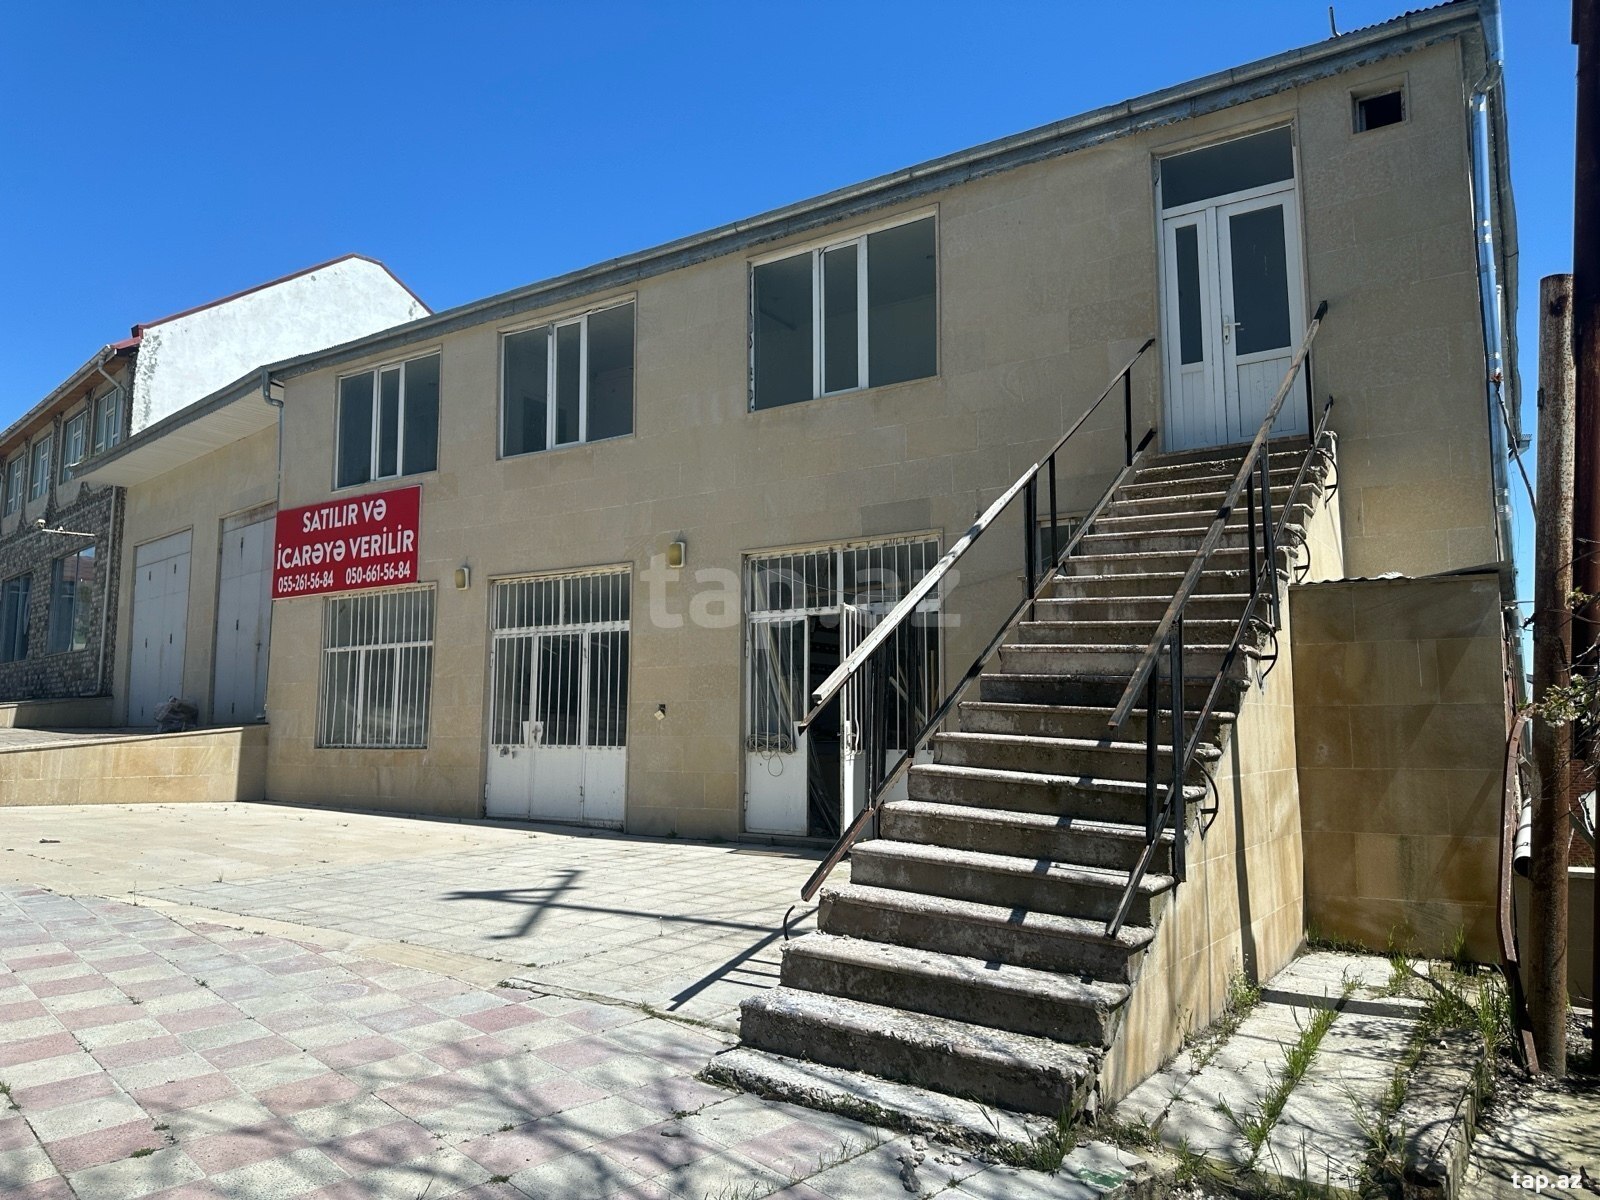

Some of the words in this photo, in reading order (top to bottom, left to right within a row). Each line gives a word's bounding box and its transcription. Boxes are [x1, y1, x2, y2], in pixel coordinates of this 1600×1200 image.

[302, 503, 358, 533] SATILIR
[362, 499, 387, 523] VƏ
[277, 540, 346, 569] İCARƏYƏ
[349, 524, 415, 559] VERİLİR
[278, 570, 334, 593] 055-261-56-84
[345, 560, 411, 585] 050-661-56-84
